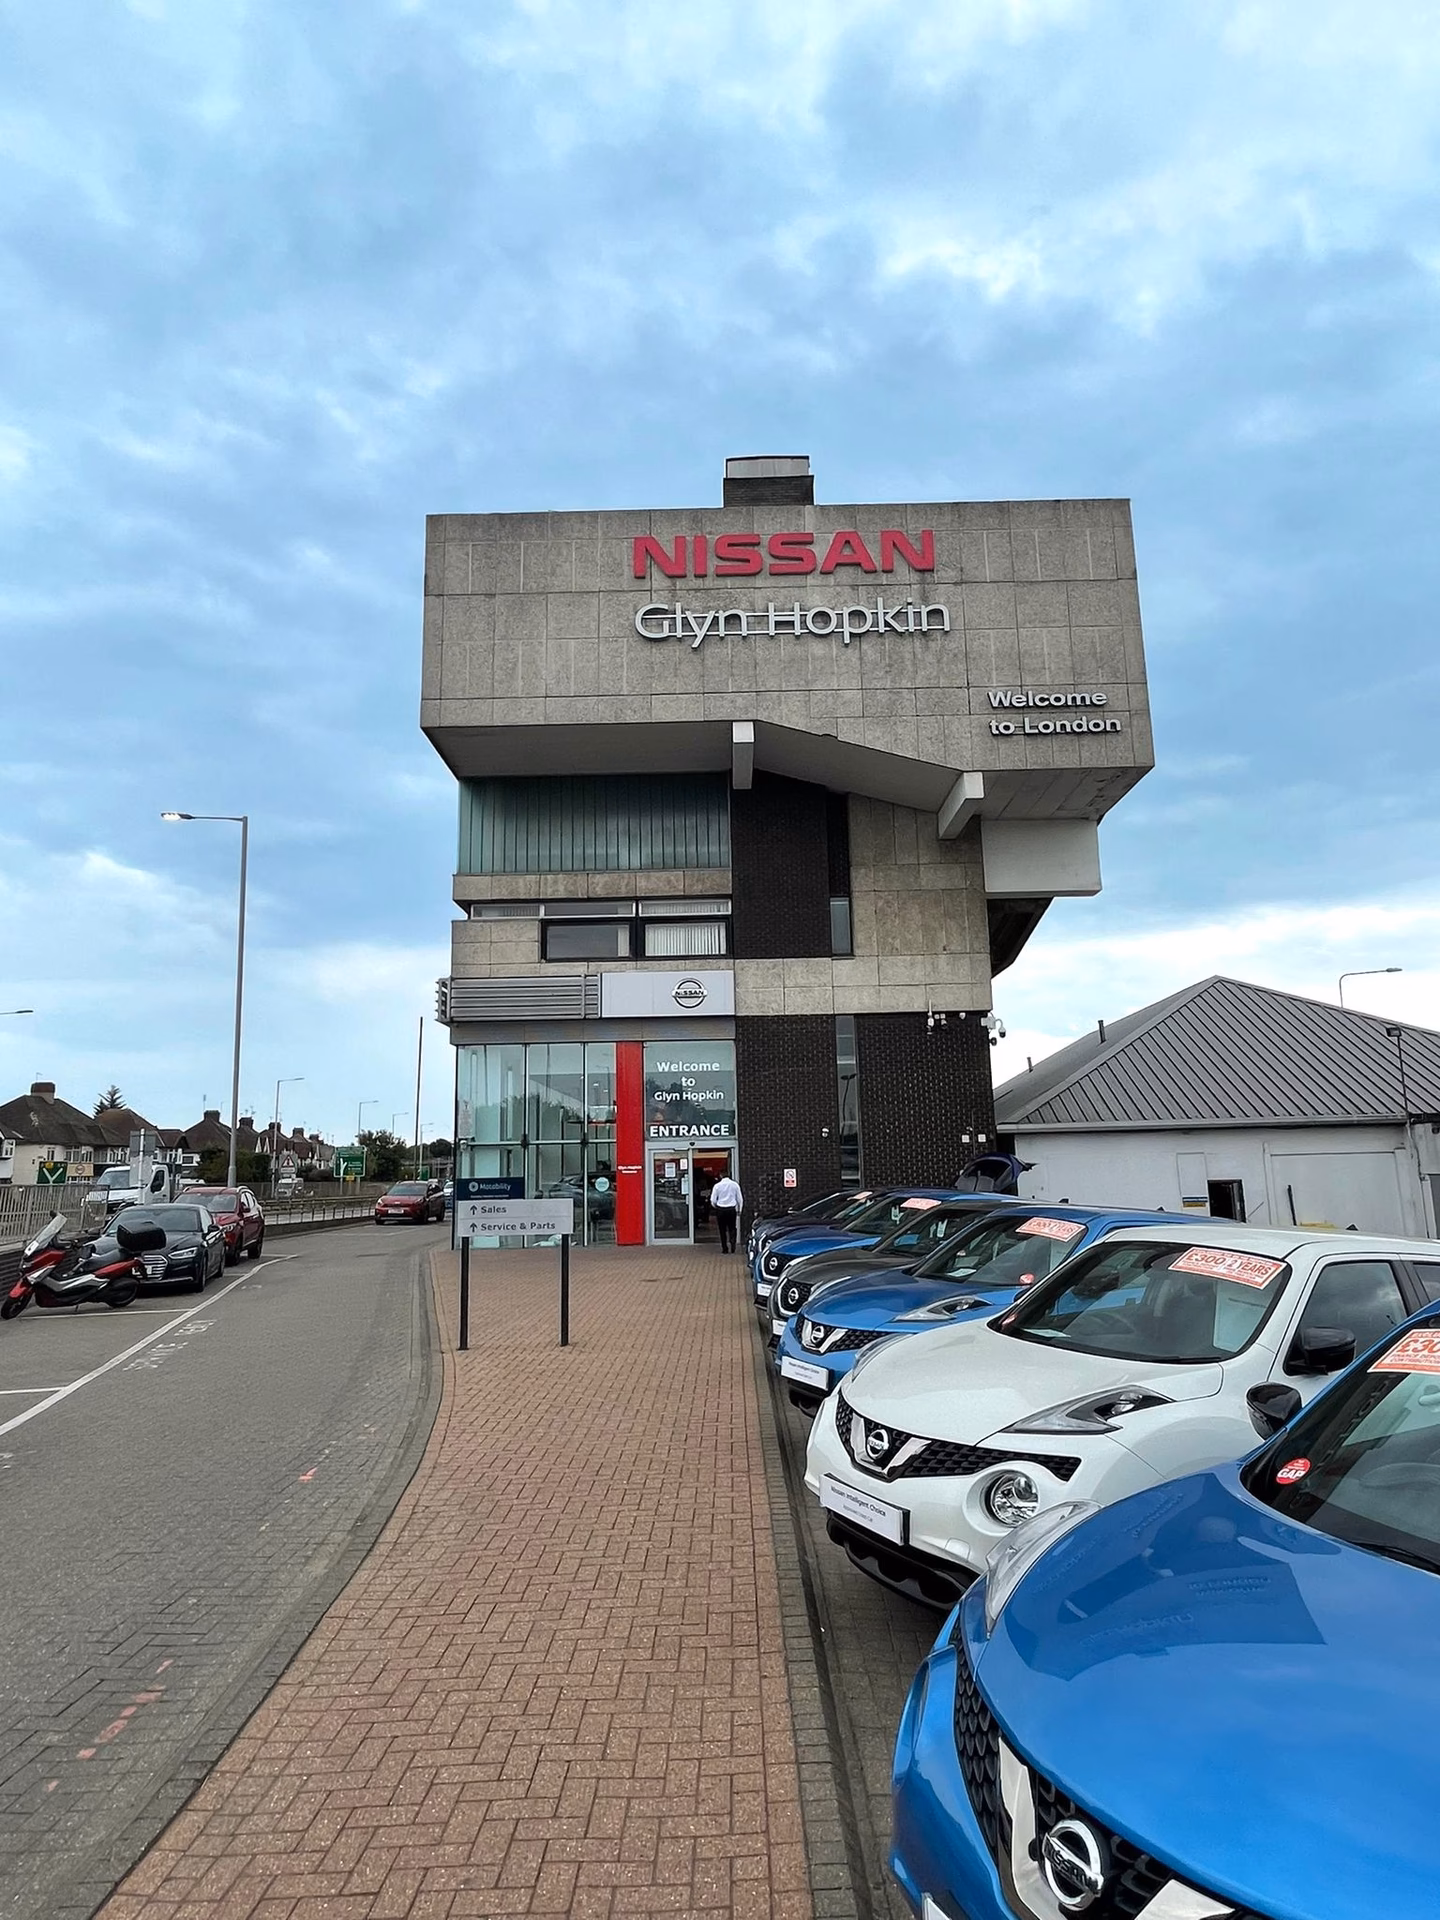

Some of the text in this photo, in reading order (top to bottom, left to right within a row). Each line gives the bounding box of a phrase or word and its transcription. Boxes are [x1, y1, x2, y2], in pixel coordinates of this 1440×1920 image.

[632, 529, 935, 578] NISSAN
[634, 597, 950, 649] Glyn Hopkin
[987, 690, 1107, 708] Welcome
[989, 716, 1121, 735] to London
[656, 1061, 720, 1072] Welcome
[681, 1076, 696, 1086] to
[654, 1090, 724, 1103] Glyn Hopkin
[650, 1124, 729, 1137] ENTRANCE
[480, 1183, 511, 1191] Motability
[481, 1206, 507, 1214] Sales
[481, 1222, 556, 1232] Service & Parts
[1186, 1253, 1226, 1264] £300
[1227, 1259, 1238, 1268] 2
[1237, 1260, 1272, 1276] YEARS
[1277, 1469, 1306, 1479] GAP
